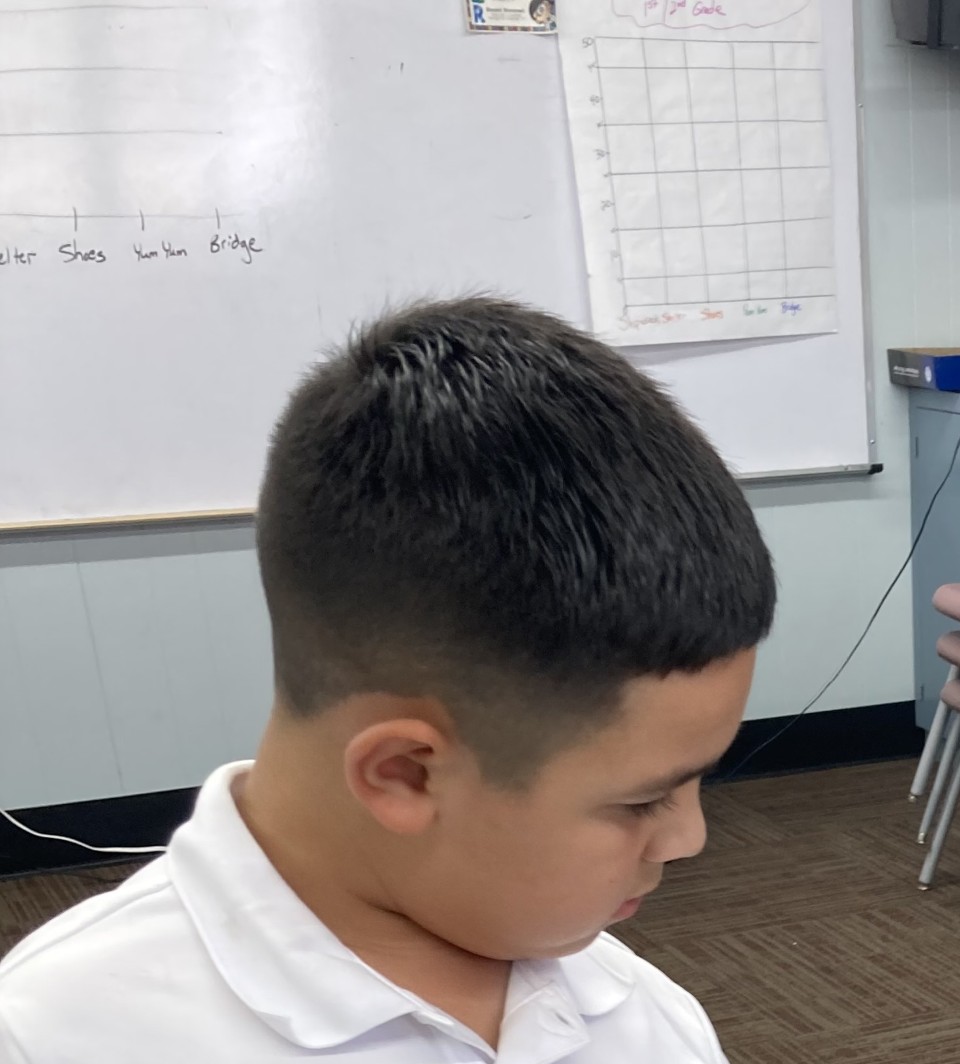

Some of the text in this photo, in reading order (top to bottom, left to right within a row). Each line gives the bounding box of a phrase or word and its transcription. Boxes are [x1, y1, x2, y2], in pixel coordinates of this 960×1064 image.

[472, 4, 486, 24] R
[58, 239, 107, 263] Shoes
[133, 242, 159, 262] Yum
[161, 240, 188, 260] Yum
[209, 234, 264, 265] Bridge
